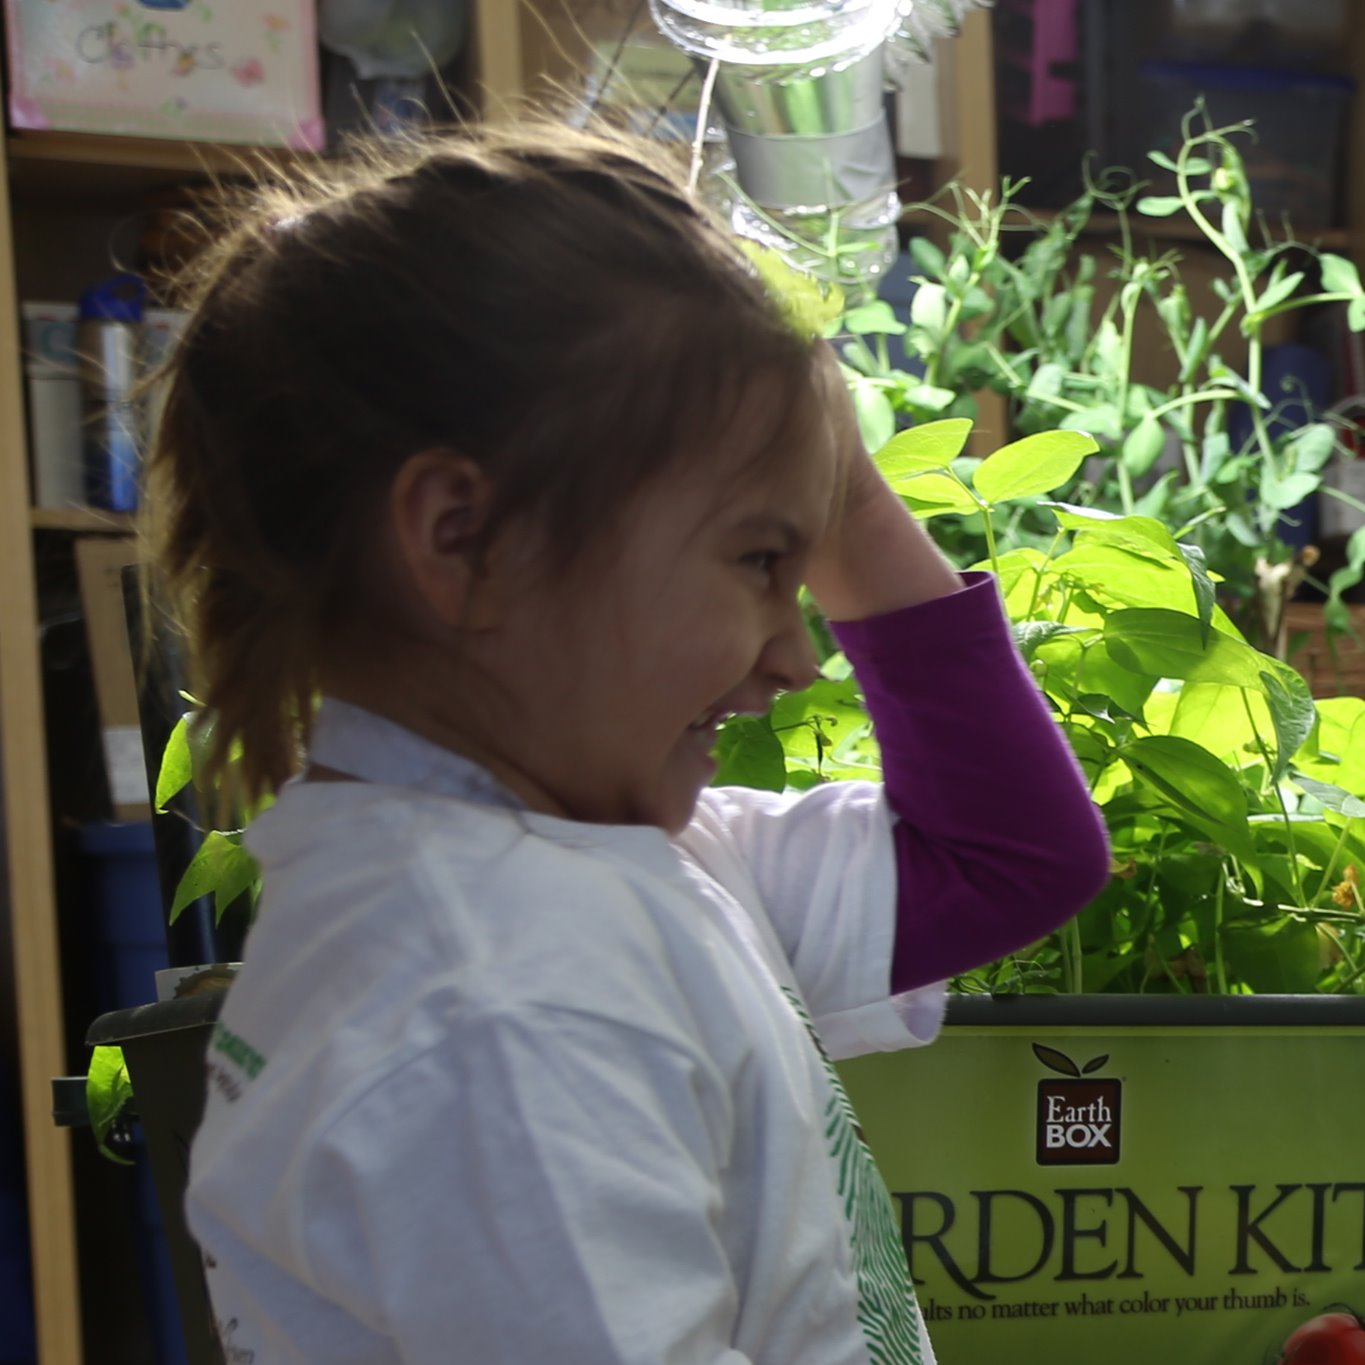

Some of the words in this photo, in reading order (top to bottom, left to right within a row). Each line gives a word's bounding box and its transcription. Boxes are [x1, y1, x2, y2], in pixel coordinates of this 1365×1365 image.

[1046, 1095, 1112, 1123] Earth
[1046, 1123, 1112, 1148] BOX
[891, 1186, 1203, 1301] RDEN
[958, 1303, 986, 1321] no
[992, 1300, 1060, 1319] matter
[1064, 1293, 1115, 1315] what
[1119, 1289, 1170, 1314] color
[1174, 1293, 1219, 1318] your
[1223, 1286, 1288, 1309] thumb
[1292, 1290, 1311, 1307] is.
